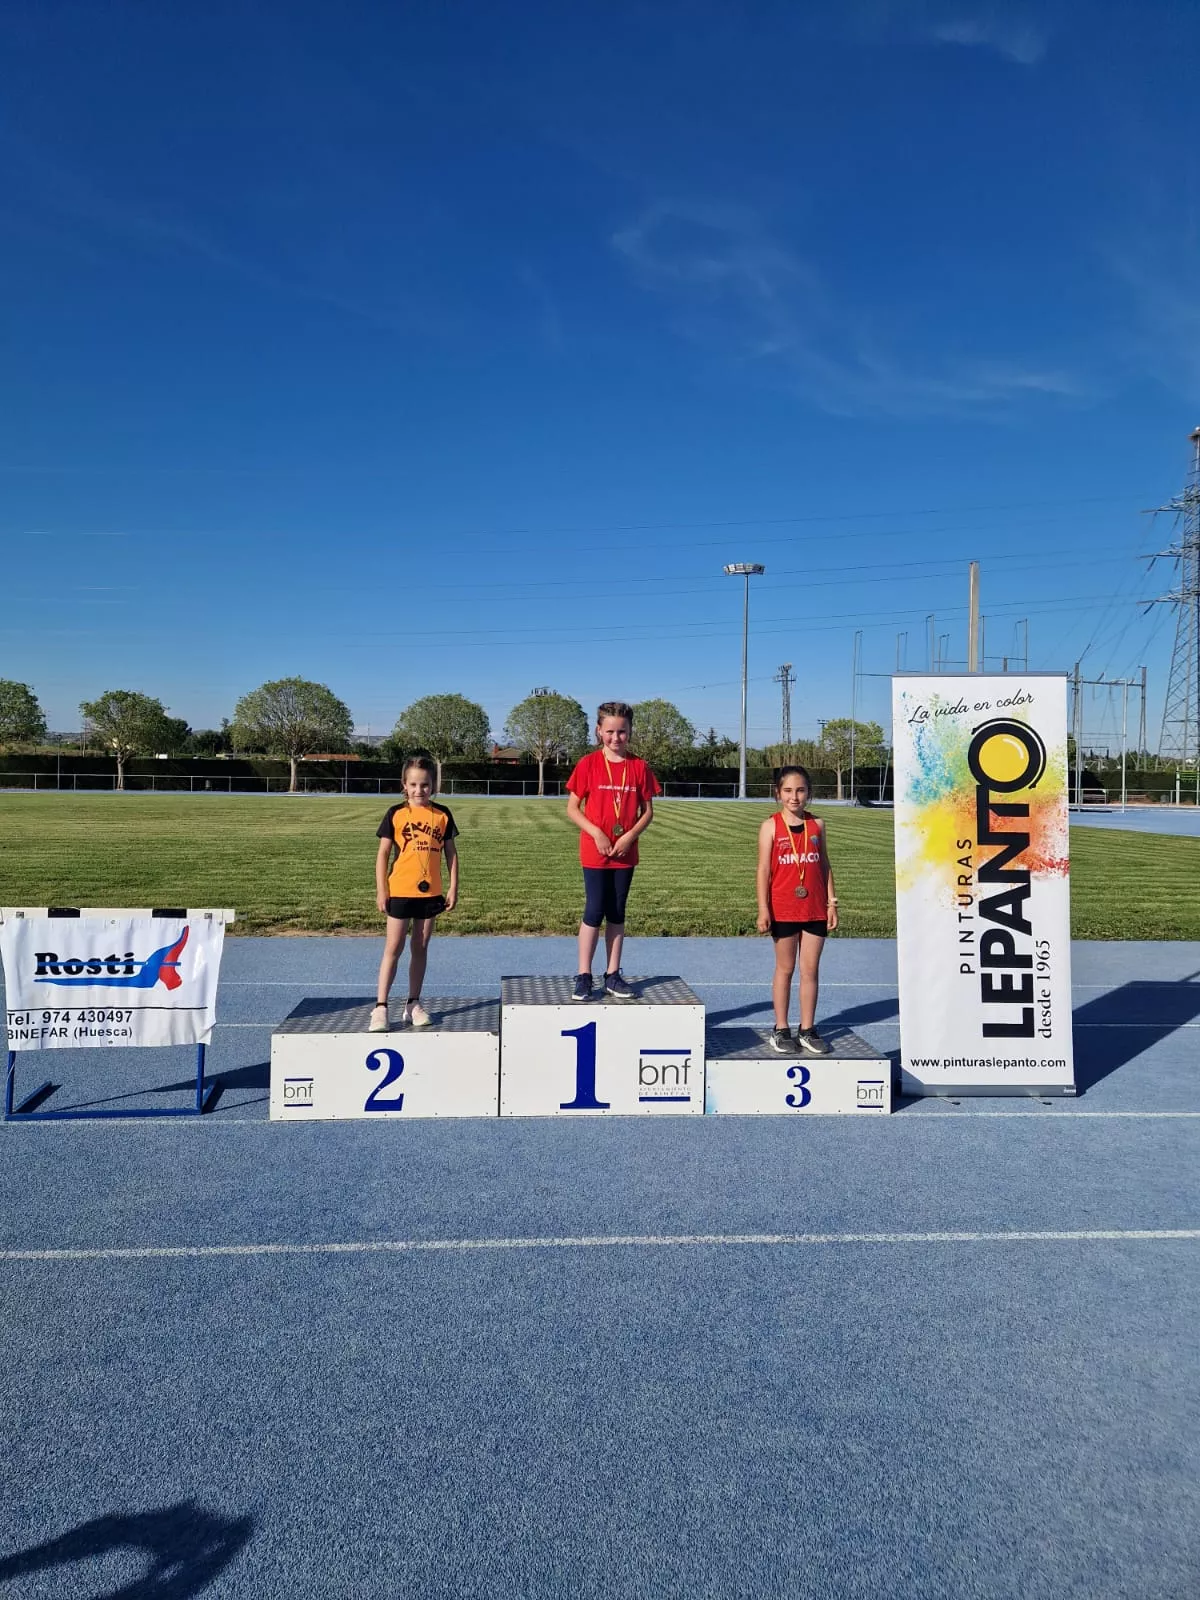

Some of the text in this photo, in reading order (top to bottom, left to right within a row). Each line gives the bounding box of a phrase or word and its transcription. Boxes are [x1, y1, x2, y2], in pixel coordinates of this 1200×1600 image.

[908, 688, 1035, 724] La vida en color
[967, 717, 1047, 1039] LEPANTO
[957, 838, 976, 975] PINTURAS
[34, 952, 136, 976] Rosti
[1035, 939, 1053, 1039] desde 1965
[7, 1010, 133, 1026] Tel. 974 430497
[73, 1026, 133, 1039] (Huesca)
[559, 1021, 611, 1110] 1
[638, 1057, 692, 1086] bnf
[910, 1056, 1067, 1070] www.pinturaslepanto.com
[283, 1082, 314, 1099] bnf
[364, 1048, 405, 1112] 2
[785, 1065, 812, 1108] 3
[856, 1084, 885, 1100] bnf
